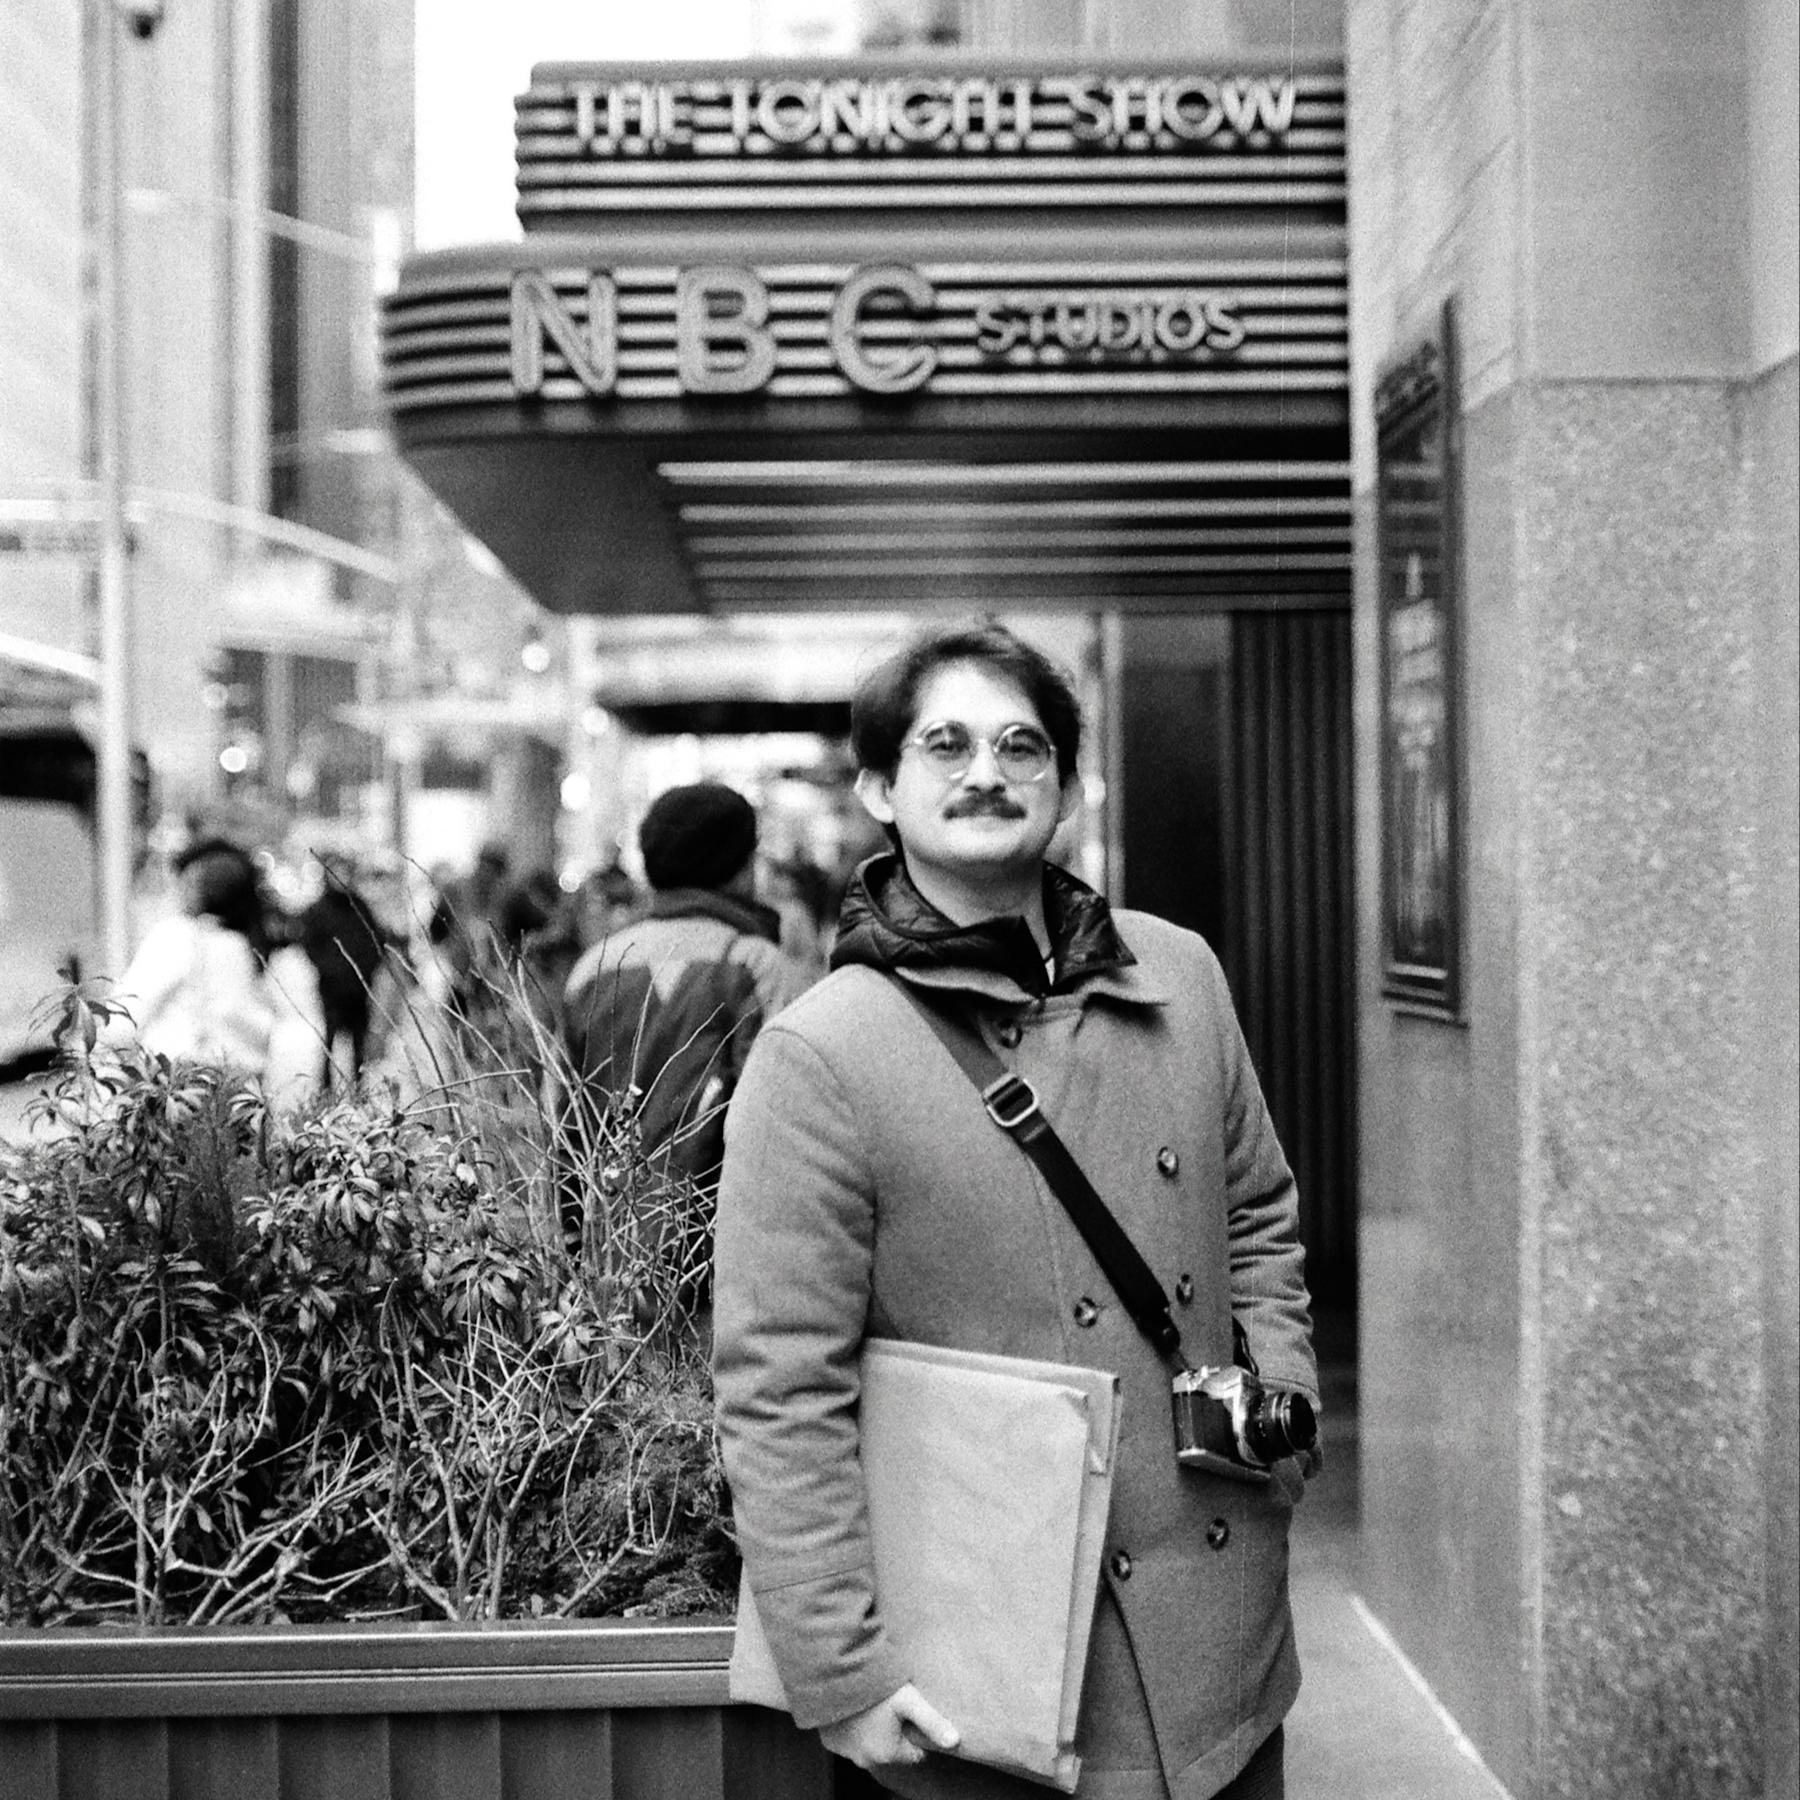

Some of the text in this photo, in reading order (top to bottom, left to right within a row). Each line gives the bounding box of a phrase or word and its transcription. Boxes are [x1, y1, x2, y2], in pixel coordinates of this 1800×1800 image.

[567, 76, 1296, 144] THE TONIGHT SHOW
[509, 265, 1245, 394] NBC STUDIOS
